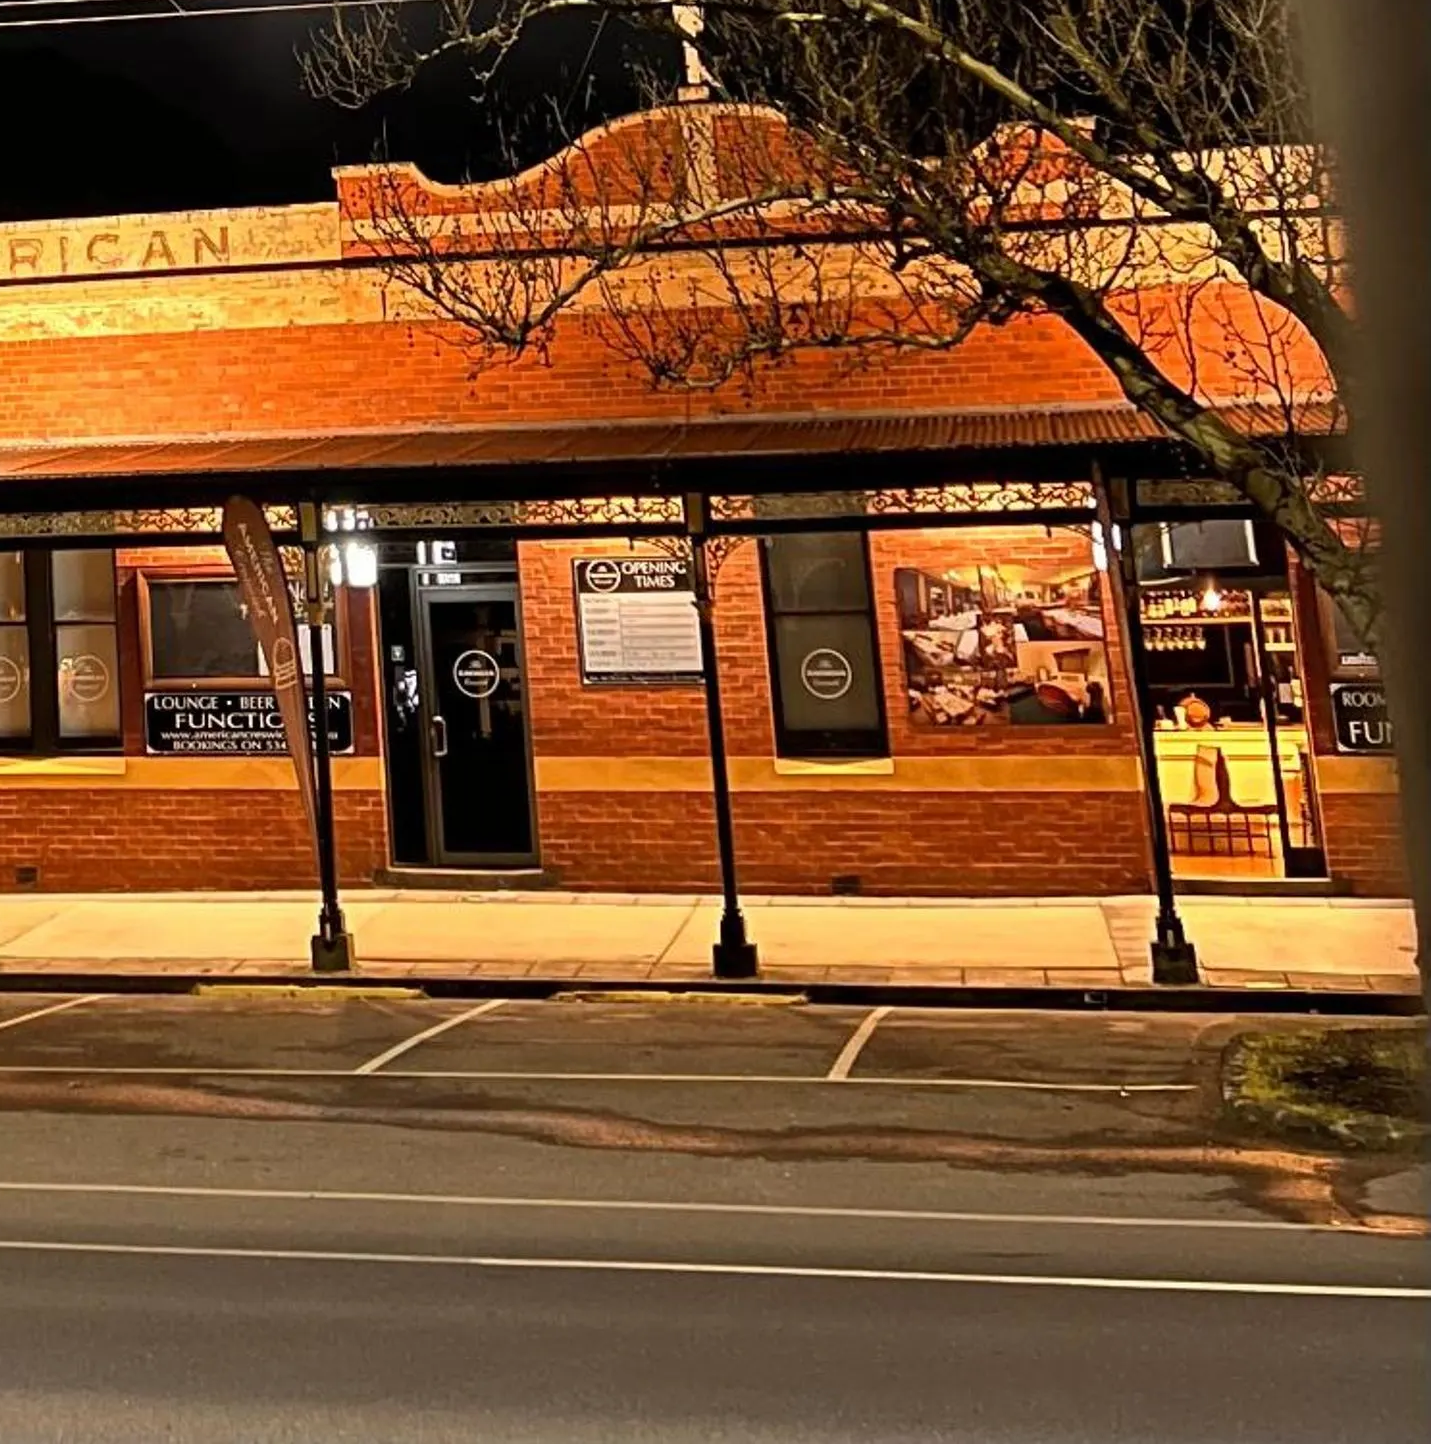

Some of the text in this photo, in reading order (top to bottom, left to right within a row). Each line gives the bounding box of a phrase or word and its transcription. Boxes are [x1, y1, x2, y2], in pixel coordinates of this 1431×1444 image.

[621, 561, 687, 575] OPENING
[633, 575, 676, 588] TIMES
[154, 696, 275, 710] LOUNGE BEER
[240, 740, 262, 750] ON
